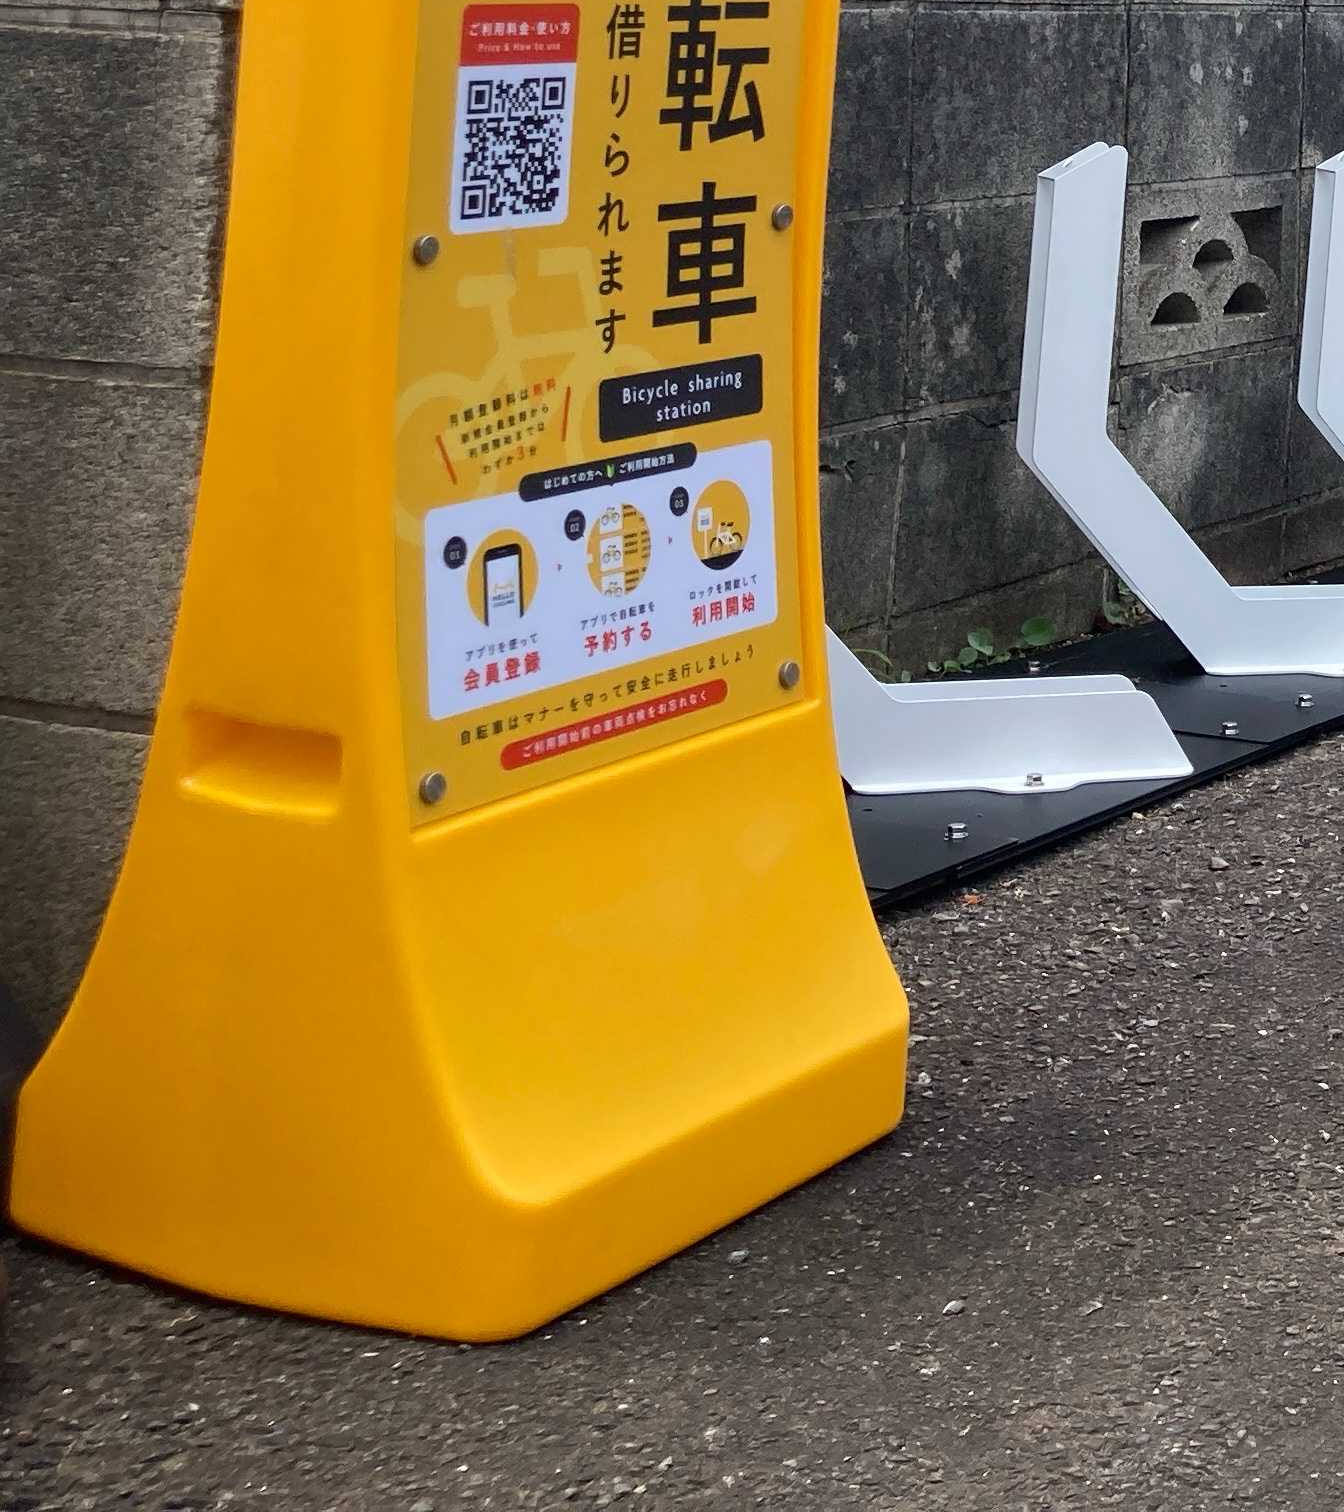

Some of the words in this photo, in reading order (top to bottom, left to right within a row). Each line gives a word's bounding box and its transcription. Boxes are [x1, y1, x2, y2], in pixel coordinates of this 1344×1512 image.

[596, 4, 646, 353] 借りられます
[622, 378, 679, 405] Bicycle
[688, 369, 743, 393] sharing
[656, 400, 711, 423] station
[544, 470, 602, 489] はじめての方へ
[692, 592, 756, 627] 利用開始
[584, 621, 652, 658] 予約する
[463, 651, 541, 692] 会員登録
